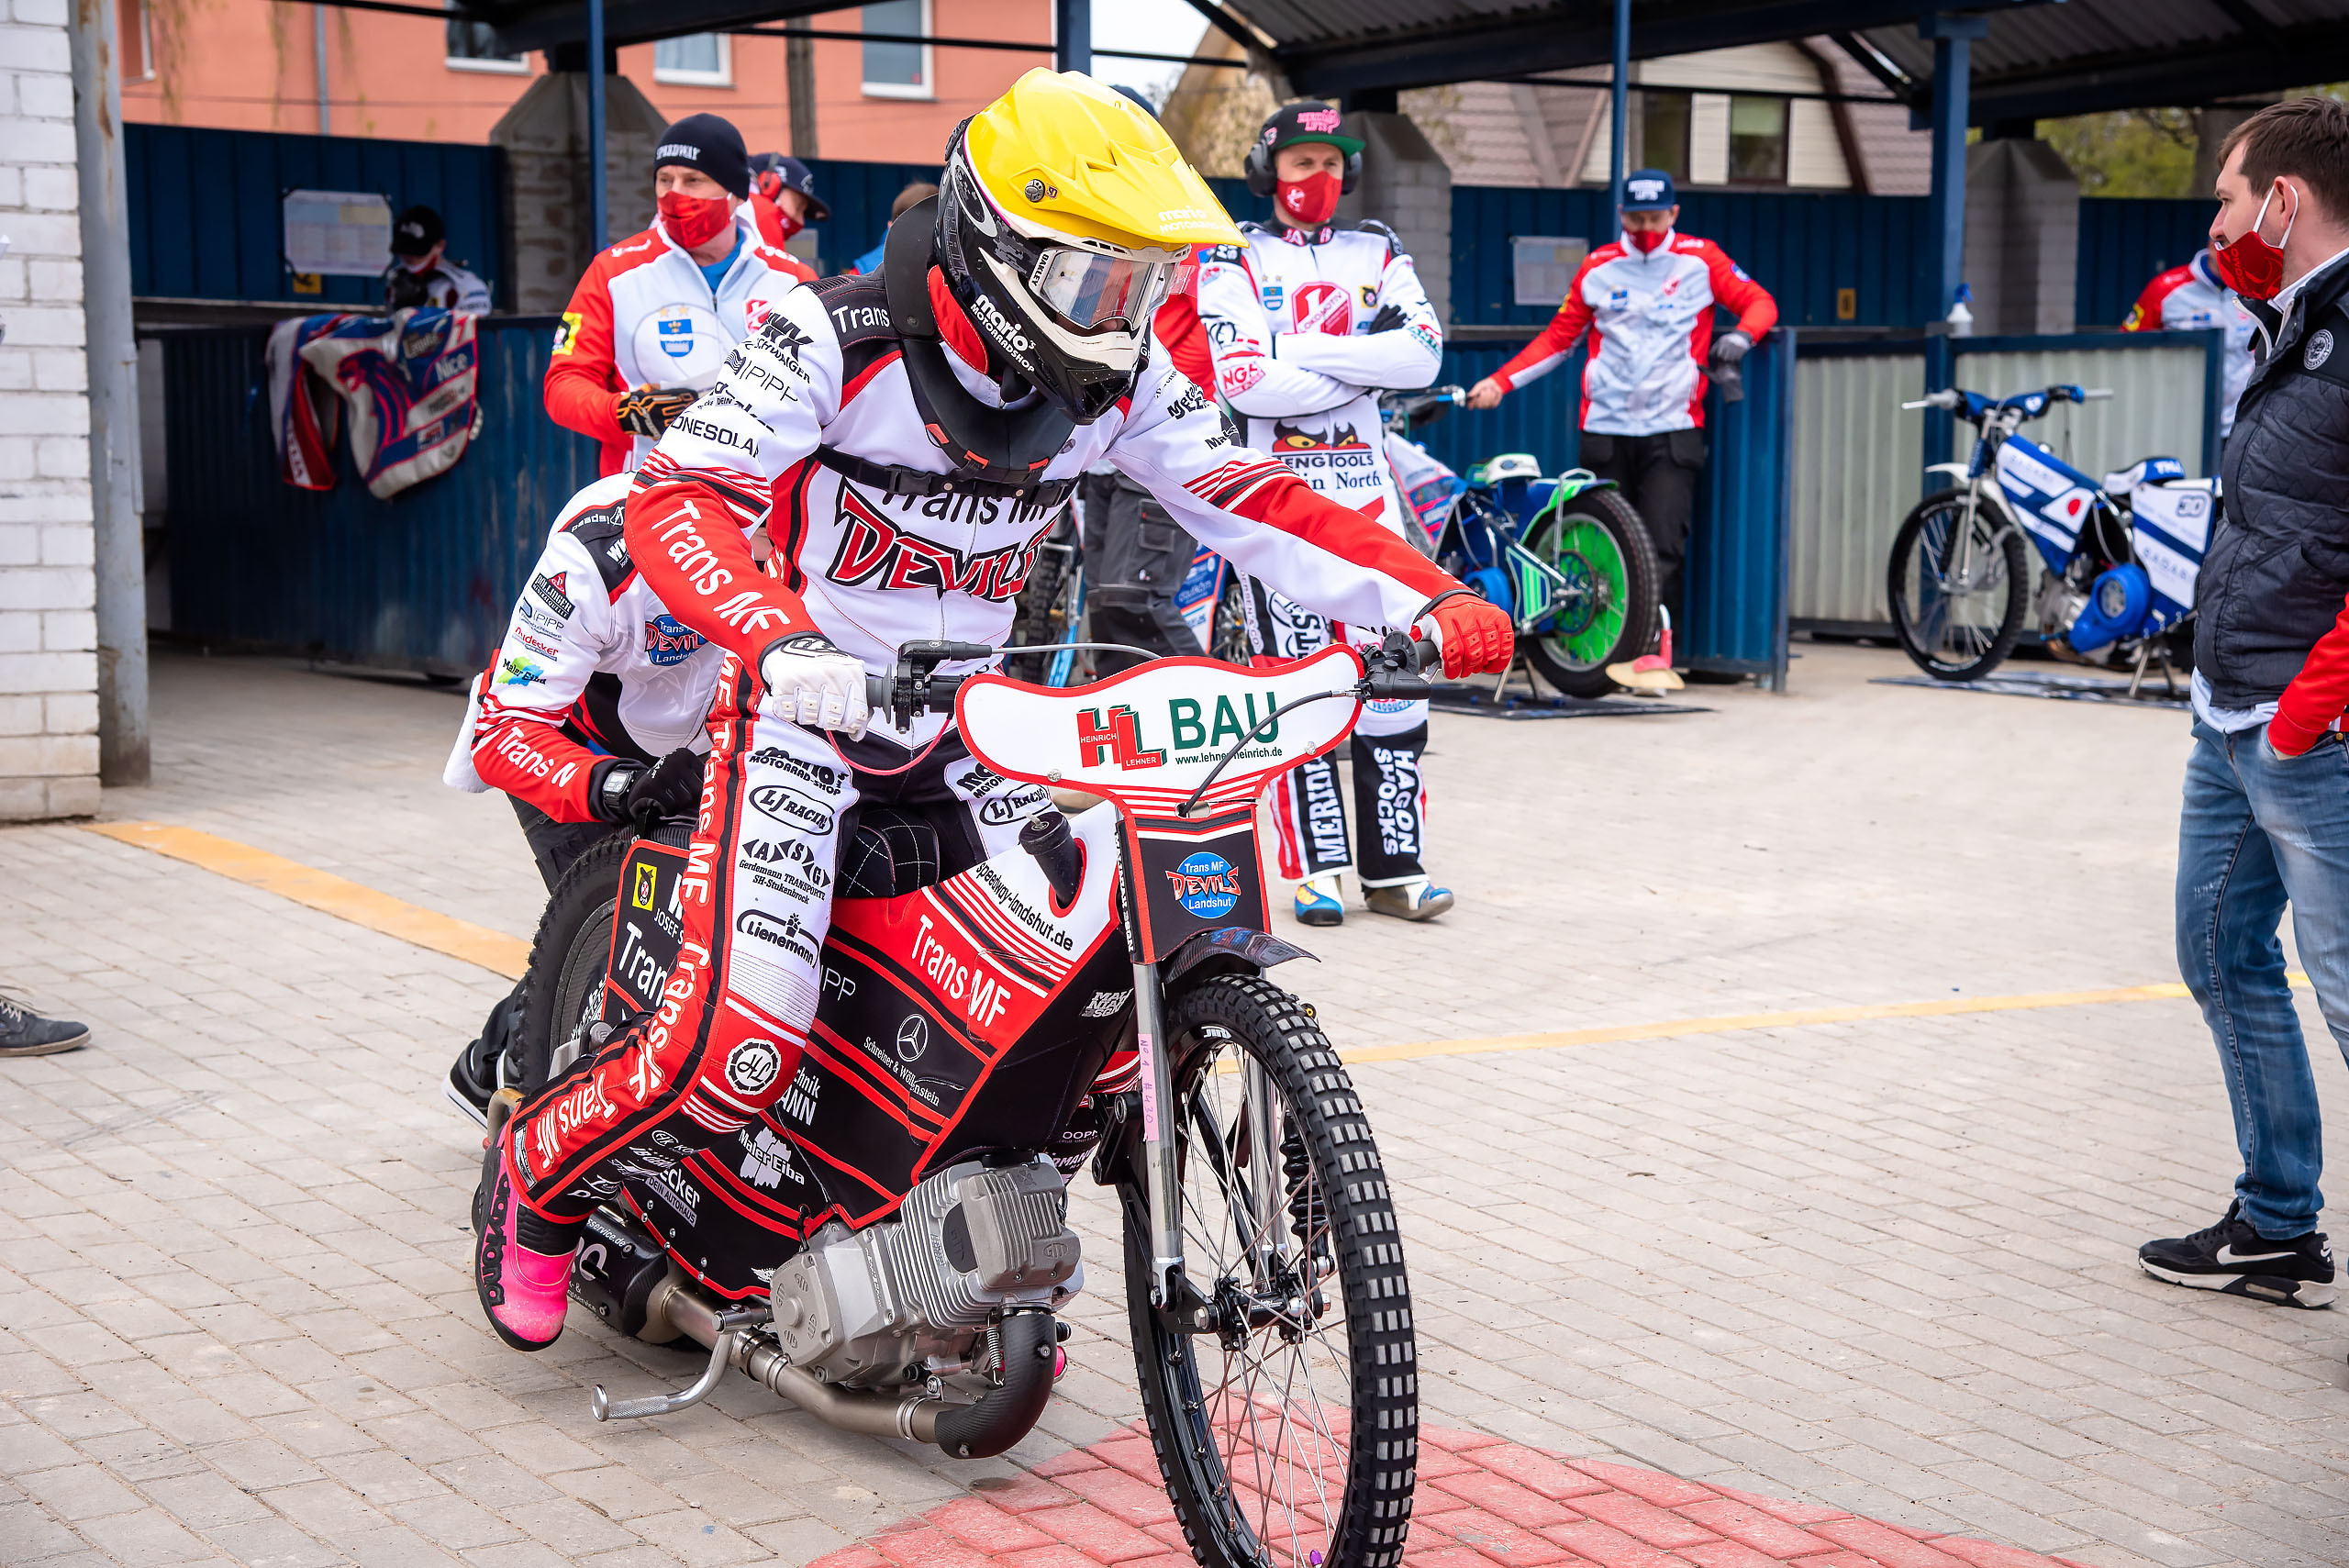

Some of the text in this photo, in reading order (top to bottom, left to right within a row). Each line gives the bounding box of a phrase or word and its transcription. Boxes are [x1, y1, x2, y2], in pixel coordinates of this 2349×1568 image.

[656, 144, 700, 161] SPEEDWAY
[1030, 253, 1050, 287] OAKLEY
[831, 305, 890, 334] Trans
[970, 303, 1036, 373] MOTORRADSHOP
[1336, 471, 1383, 490] North
[651, 500, 790, 634] Trans MF
[644, 622, 705, 652] DEVIL
[660, 621, 685, 633] Trans
[503, 658, 524, 677] Maler
[1079, 732, 1117, 744] HEINRICH
[1168, 692, 1280, 751] BAU
[496, 726, 554, 778] Trans
[1125, 756, 1157, 767] LEHNER
[1175, 746, 1283, 765] www.lehneheinrich.de
[749, 755, 841, 795] MOTORRAD-SHOP
[760, 788, 790, 812] LJ
[990, 796, 1014, 819] LJ
[1374, 747, 1398, 856] SHOCKS
[1393, 749, 1418, 854] HAGON
[682, 842, 717, 904] MF
[739, 859, 827, 901] Gerdemann TRANSPORTE
[1164, 866, 1241, 901] DEVILS
[1185, 861, 1224, 873] Trans MF
[752, 874, 810, 905] SH-Stukenbrock
[975, 862, 1074, 952] speedway-landshut.de
[1188, 896, 1231, 910] Landshut
[653, 907, 679, 940] JOSEF
[746, 918, 816, 966] Lienemann
[618, 921, 668, 1008] Tran
[910, 914, 1011, 1028] Trans MF
[650, 941, 711, 1050] Trans
[863, 1036, 895, 1069] Schreiner
[892, 1061, 899, 1074] &
[793, 1066, 821, 1099] chnik
[559, 1073, 617, 1135] Trans
[780, 1084, 817, 1127] ANN
[738, 1129, 806, 1185] Maler Eiba
[648, 1175, 696, 1224] DEIN AUTOHAUS
[587, 1218, 627, 1248] sservice.de
